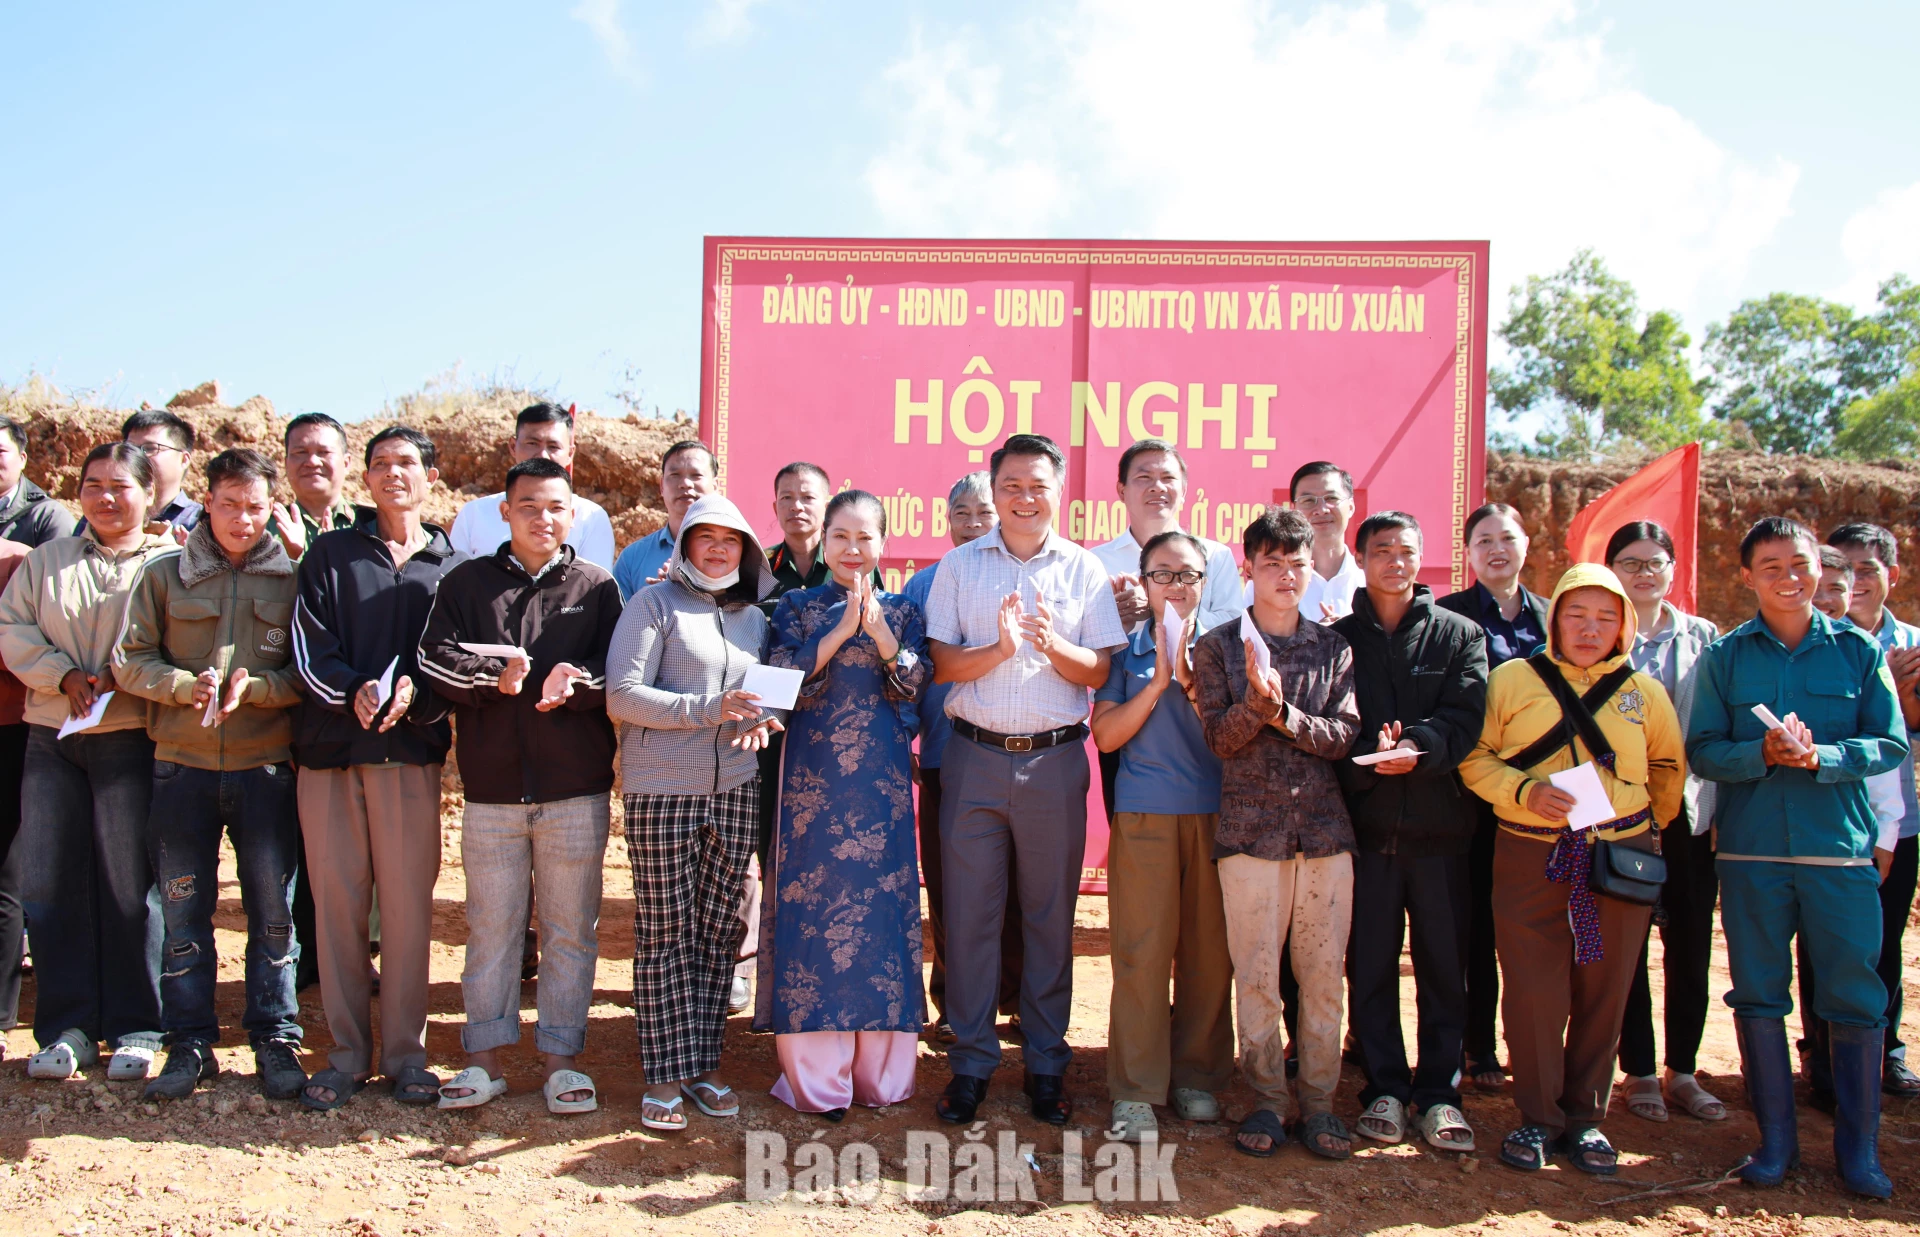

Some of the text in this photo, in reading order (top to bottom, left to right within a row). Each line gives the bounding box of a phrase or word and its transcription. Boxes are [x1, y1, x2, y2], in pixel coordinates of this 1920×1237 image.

[762, 273, 832, 325] ĐẢNG
[840, 274, 873, 325] ỦY
[897, 288, 968, 326] HĐND
[994, 289, 1065, 327] UBND
[1090, 290, 1196, 333] UBMTTQ
[1204, 291, 1238, 330] VN
[1246, 284, 1282, 331] XÃ
[1290, 284, 1344, 332] PHÚ
[1351, 285, 1425, 332] XUÂN
[893, 355, 1278, 468] HỘI NGHỊ
[877, 488, 924, 537] ỨC
[1069, 499, 1127, 541] GIAO
